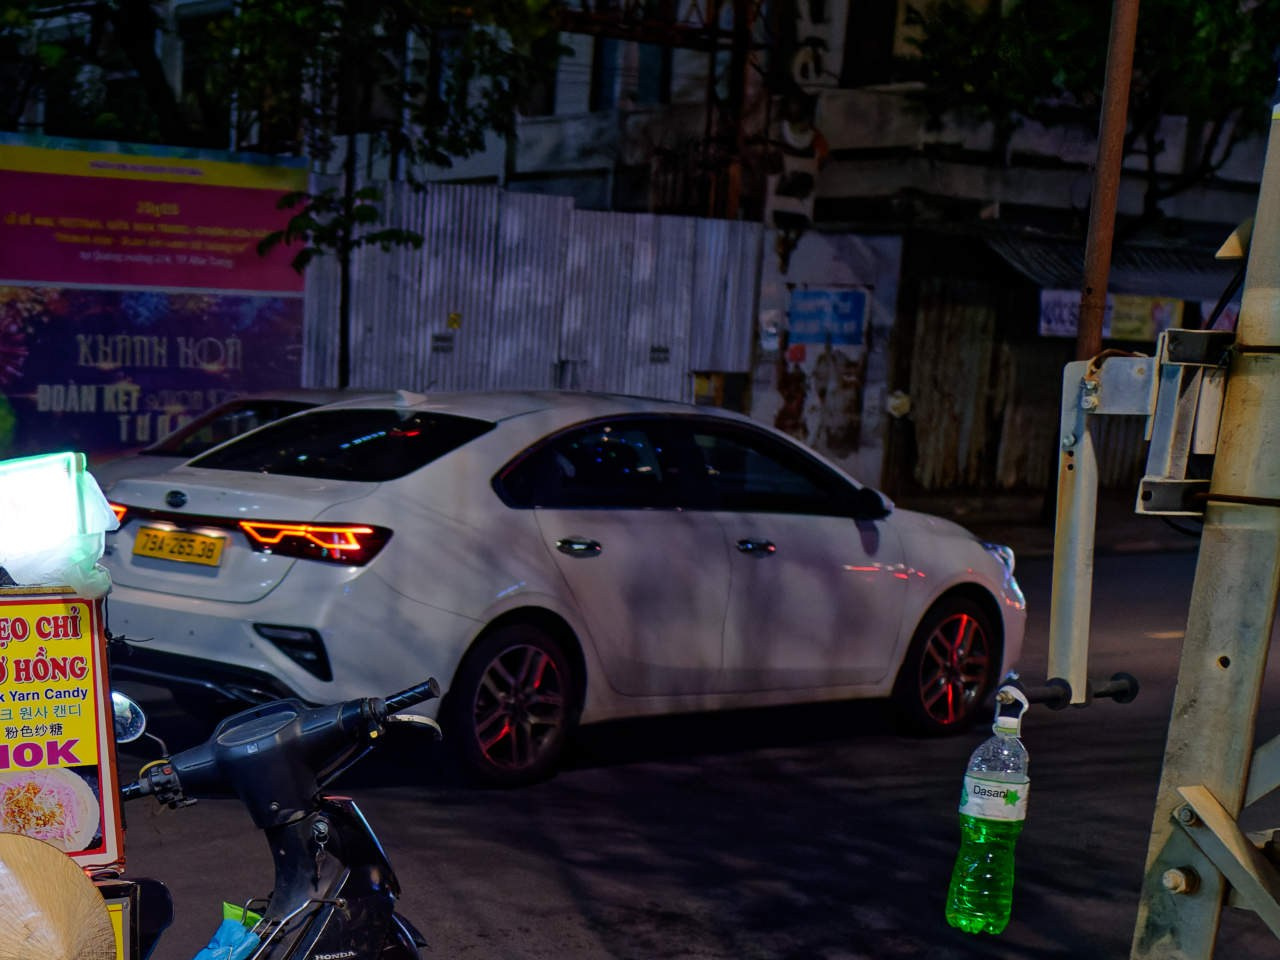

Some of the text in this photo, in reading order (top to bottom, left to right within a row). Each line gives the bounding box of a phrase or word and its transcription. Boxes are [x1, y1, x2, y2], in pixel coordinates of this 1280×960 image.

[35, 606, 82, 639] CHỈ
[13, 646, 89, 683] HỒNG
[9, 690, 40, 702] Yarn
[44, 687, 88, 701] Candy
[20, 705, 48, 720] 원사
[53, 703, 82, 718] 캔디
[5, 723, 63, 739] 粉色纱糖
[314, 951, 358, 960] HONDA
